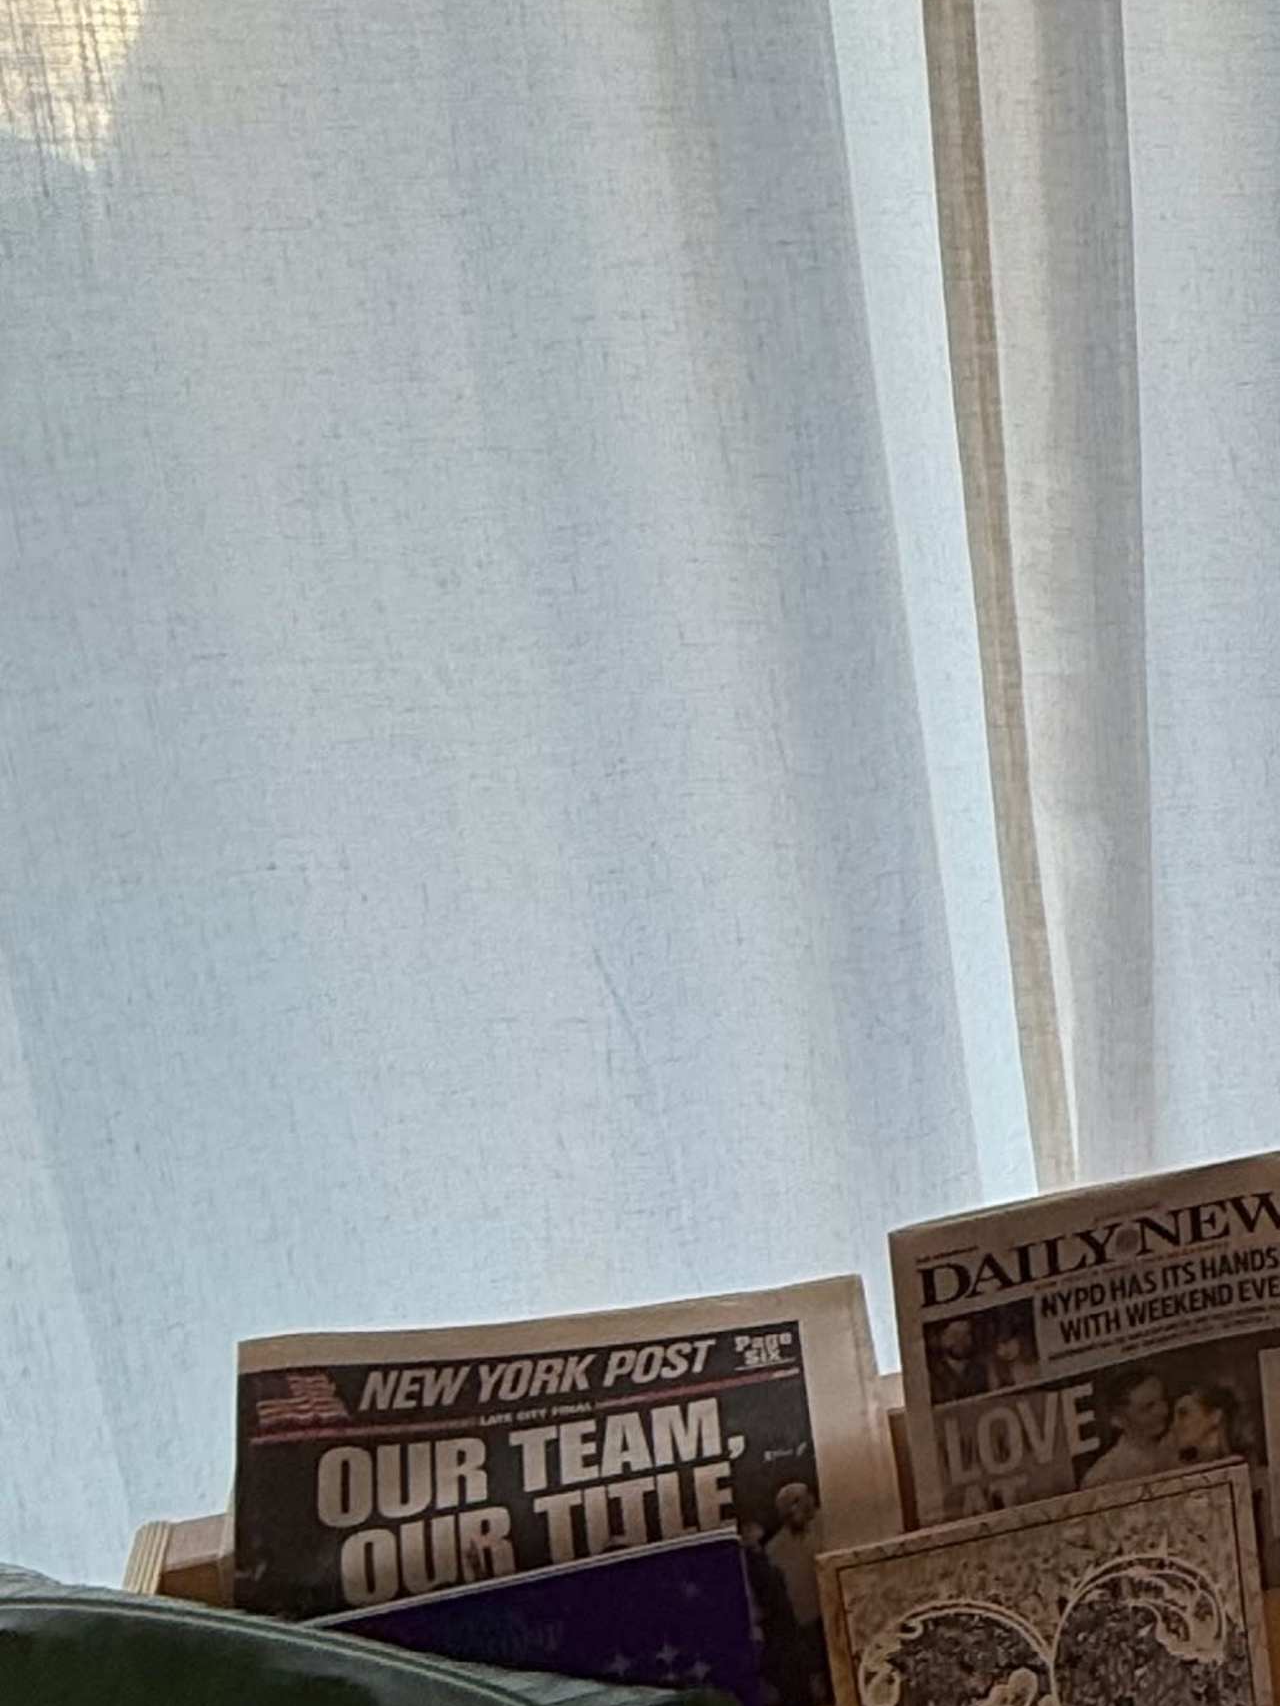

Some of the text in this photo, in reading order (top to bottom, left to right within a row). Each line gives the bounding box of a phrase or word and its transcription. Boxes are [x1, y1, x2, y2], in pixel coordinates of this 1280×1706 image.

[916, 1220, 1122, 1308] DAILY
[1041, 1283, 1104, 1318] NYPD
[1111, 1270, 1156, 1301] HAS
[1162, 1262, 1195, 1291] ITS
[1201, 1245, 1278, 1280] HANDS
[735, 1333, 791, 1352] Page
[1060, 1308, 1121, 1344] WITH
[1127, 1284, 1232, 1326] WEEKEND
[358, 1339, 716, 1412] NEW YORK POST
[516, 1407, 548, 1422] CITY
[945, 1381, 1101, 1484] LOVE
[318, 1398, 746, 1529] OUR TEAM,
[341, 1463, 738, 1606] OUR TITLE
